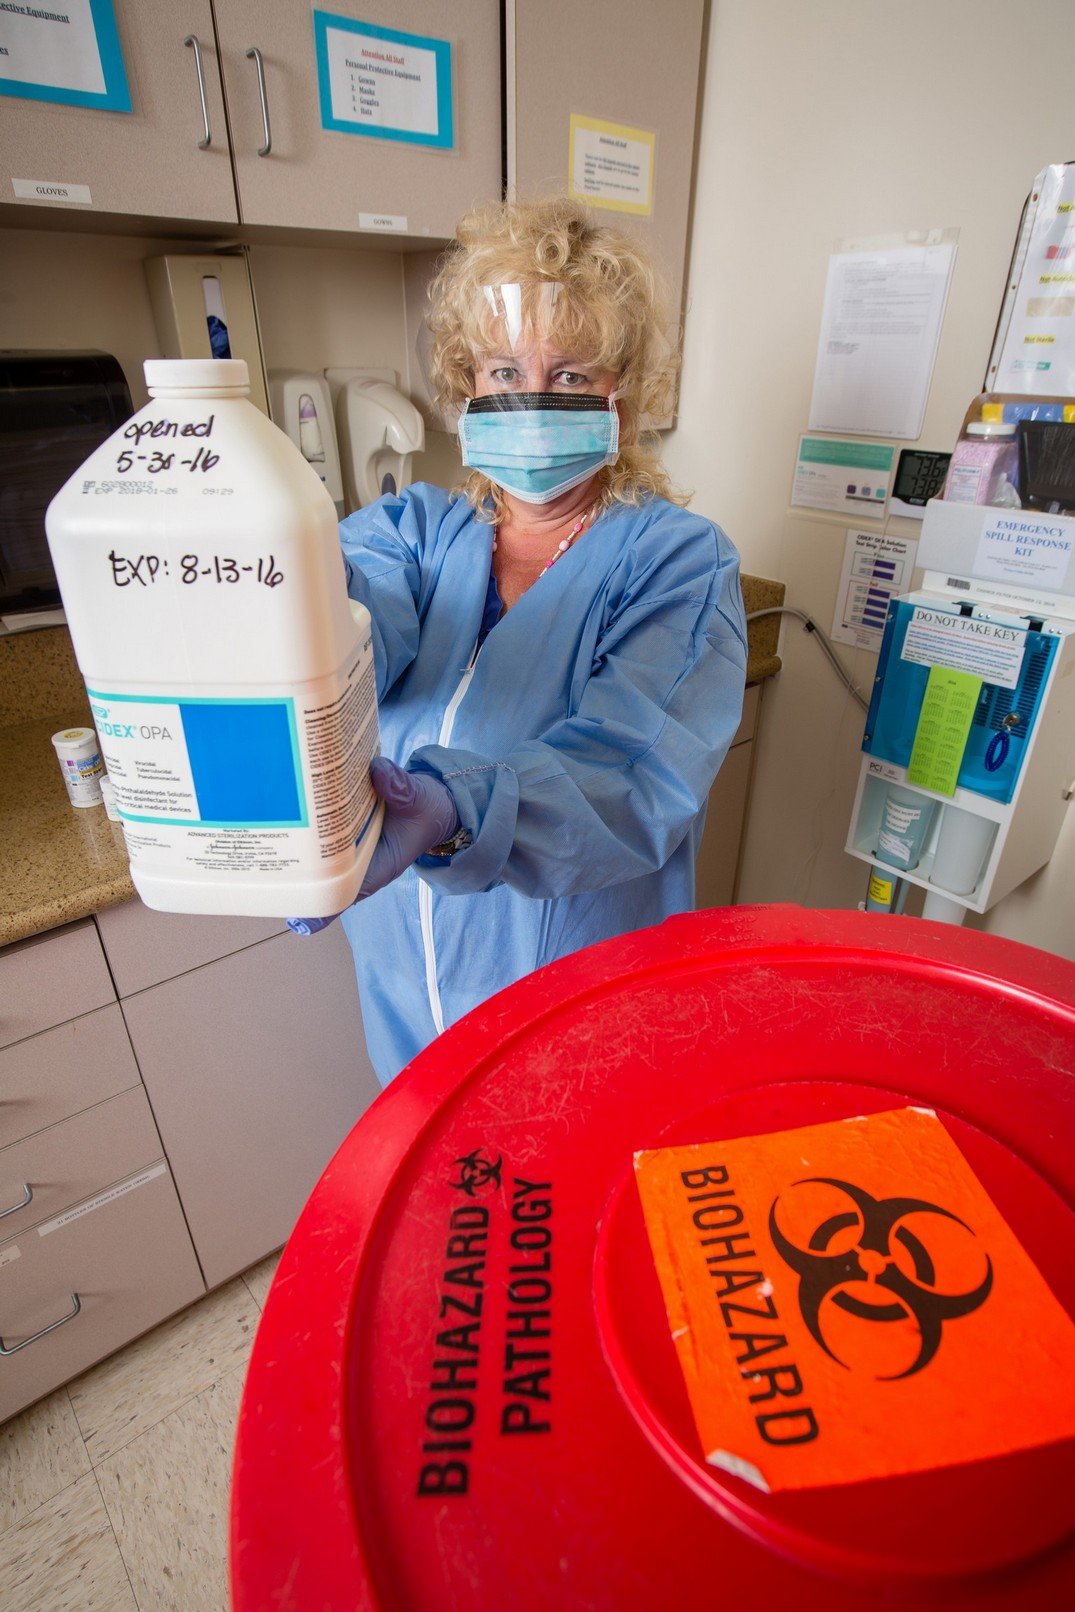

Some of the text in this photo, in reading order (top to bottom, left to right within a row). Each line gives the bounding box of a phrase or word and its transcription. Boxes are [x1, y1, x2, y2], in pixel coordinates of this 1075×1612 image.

[26, 6, 70, 24] Equipment
[345, 59, 421, 82] Personal Protective Equipment
[358, 76, 376, 86] Gowns
[36, 186, 68, 197] GLOVES
[124, 414, 216, 446] opened
[996, 520, 1066, 538] EMERGENCY
[985, 530, 1073, 552] SPILL RESPONSE
[1014, 546, 1034, 557] KIT
[180, 554, 284, 588] 8-13-16
[916, 610, 932, 622] DO
[935, 614, 958, 627] NOT
[960, 620, 991, 636] TAKE
[993, 626, 1020, 642] KEY
[140, 725, 173, 741] OPA
[870, 762, 883, 772] PCI
[499, 1176, 553, 1437] PATHOLOGY
[680, 1164, 820, 1446] BIOHAZARD
[416, 1205, 490, 1498] BIOHAZARD
